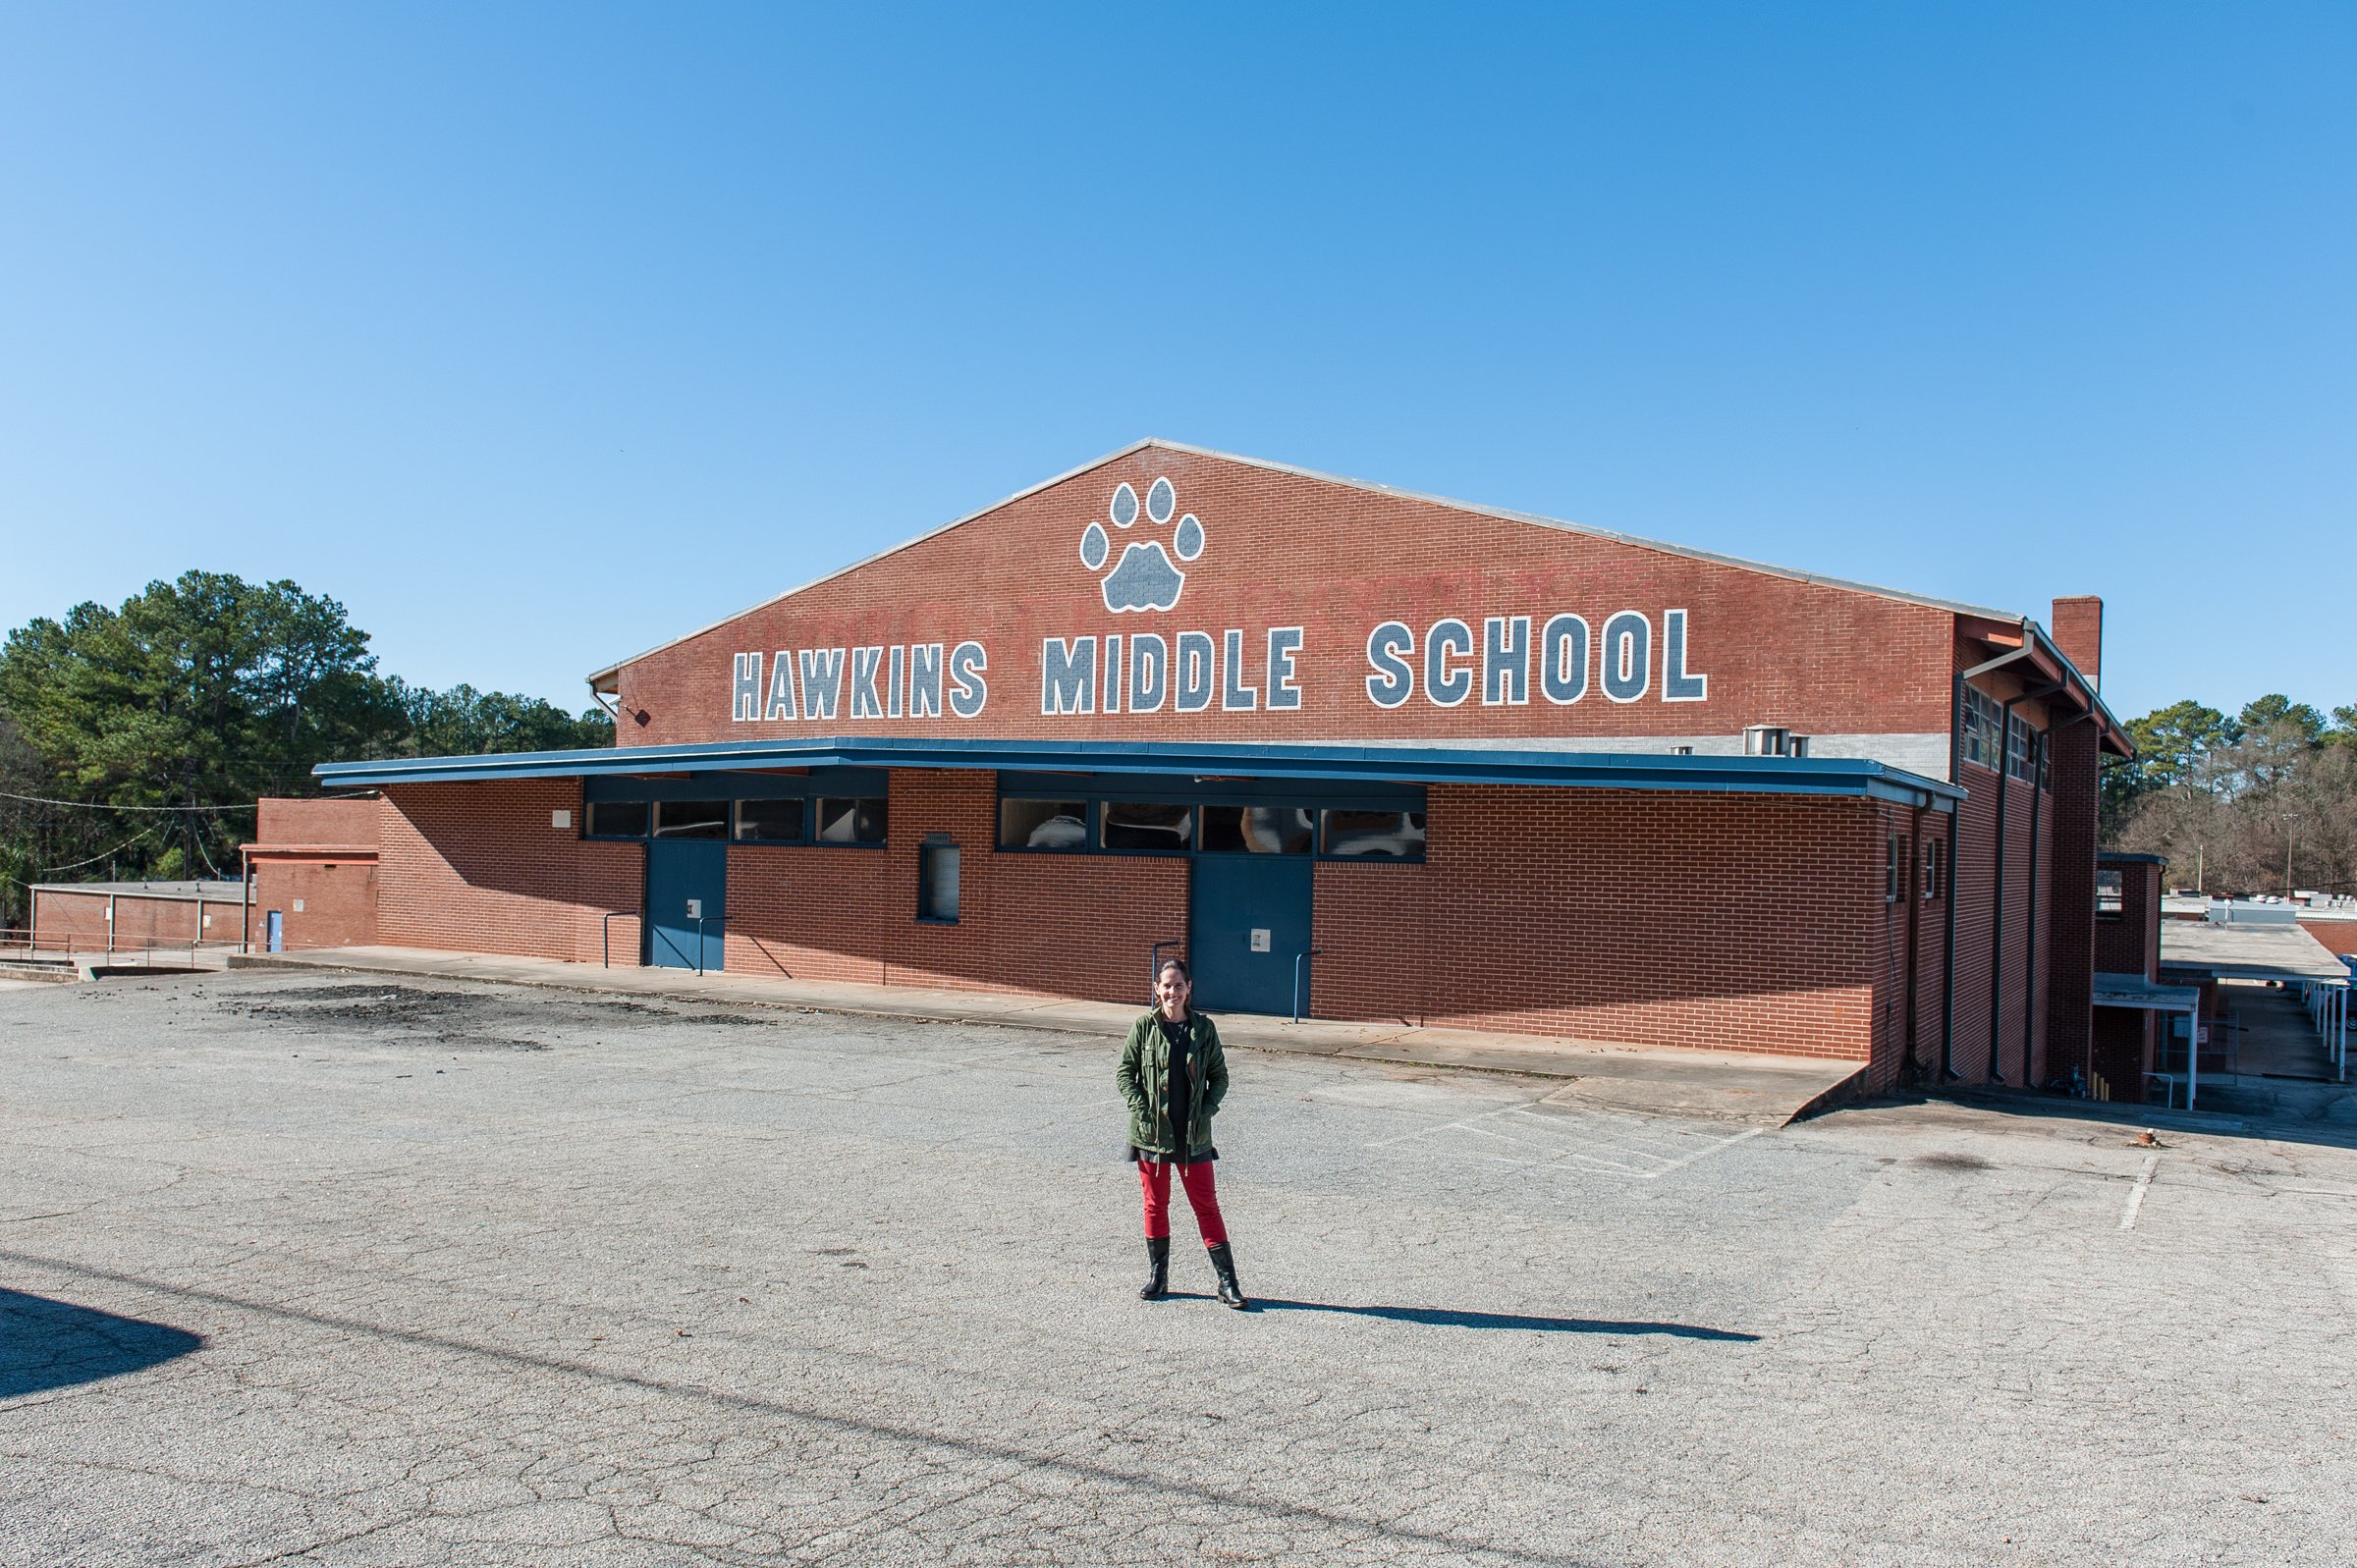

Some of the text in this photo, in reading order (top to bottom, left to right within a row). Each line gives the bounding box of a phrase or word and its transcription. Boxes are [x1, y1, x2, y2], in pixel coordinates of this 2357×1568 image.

[732, 608, 1708, 722] HAWKINS MIDDLE SCHOOL
